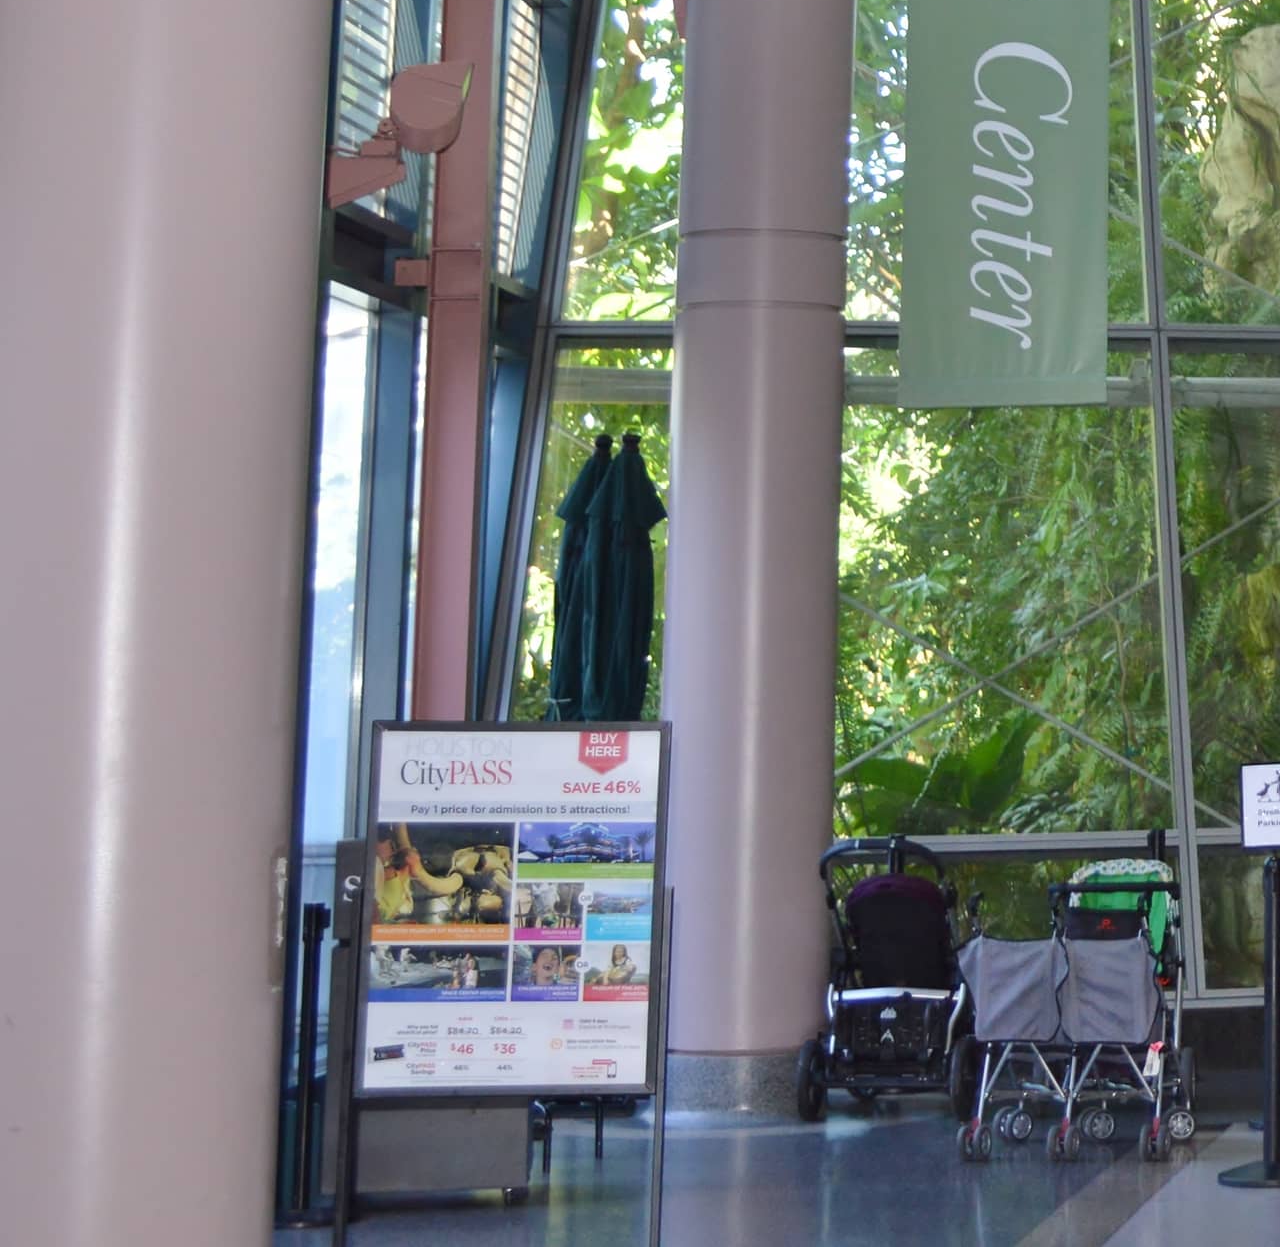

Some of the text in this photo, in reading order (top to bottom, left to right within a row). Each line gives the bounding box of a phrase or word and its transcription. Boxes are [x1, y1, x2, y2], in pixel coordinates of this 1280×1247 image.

[969, 41, 1073, 351] Center
[589, 732, 618, 745] BUY
[584, 745, 622, 758] HERE
[400, 759, 513, 793] CityPASS
[562, 780, 641, 794] SAVE 46%
[410, 804, 430, 816] Pay
[441, 804, 468, 816] price
[471, 804, 486, 814] for
[488, 804, 543, 814] admission
[546, 805, 557, 814] to
[560, 805, 567, 814] 5
[569, 804, 631, 814] attractions!
[450, 1042, 475, 1055] $46
[493, 1042, 517, 1055] $36
